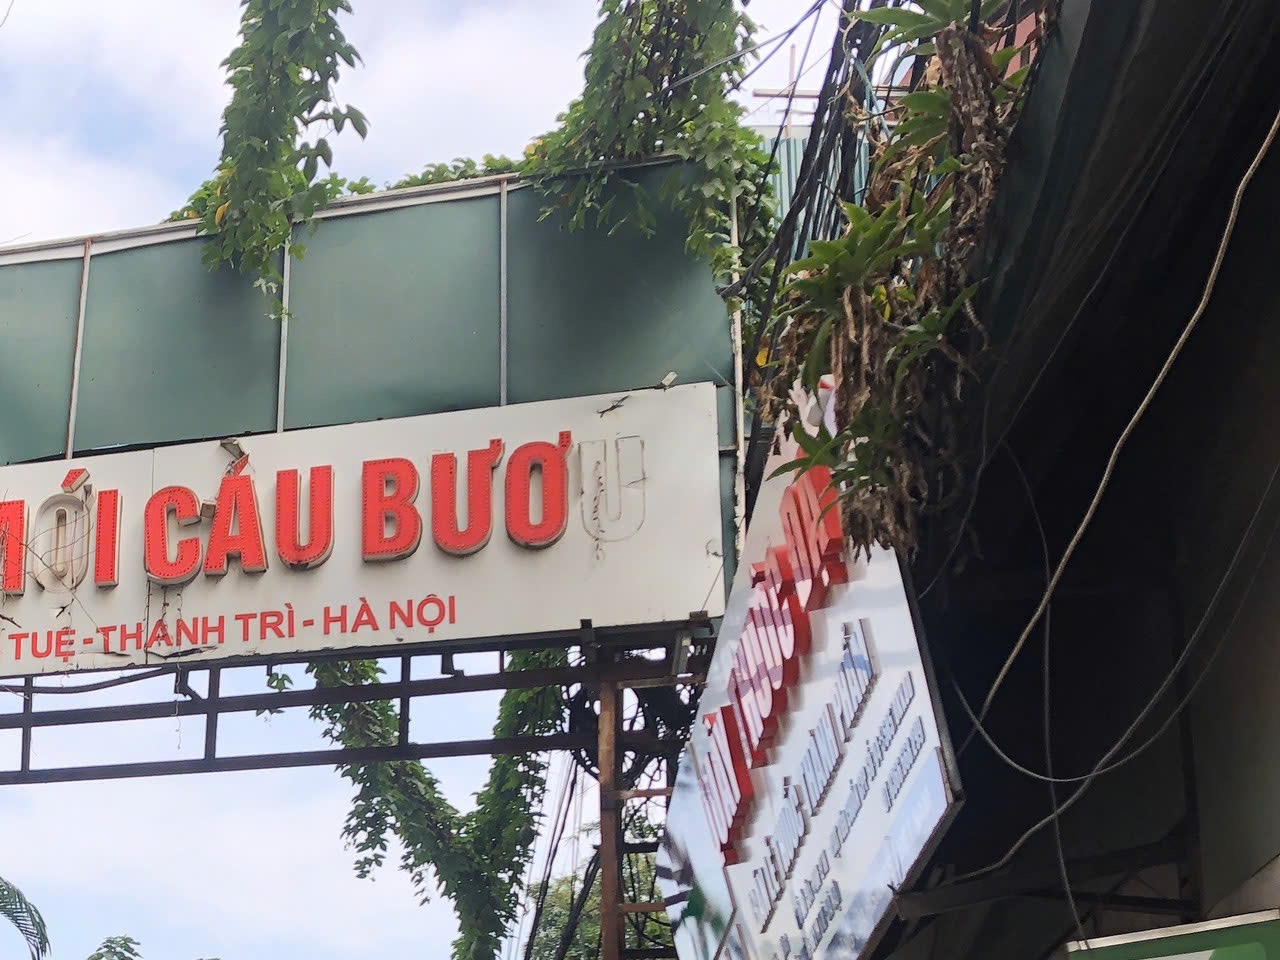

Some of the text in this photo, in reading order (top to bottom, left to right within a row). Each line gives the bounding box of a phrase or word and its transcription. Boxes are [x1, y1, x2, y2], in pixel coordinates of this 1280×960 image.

[8, 626, 76, 663] TUỆ
[96, 615, 226, 655] THANH
[234, 602, 296, 642] TRÌ
[323, 596, 381, 636] HÀ
[389, 592, 456, 634] NỘI
